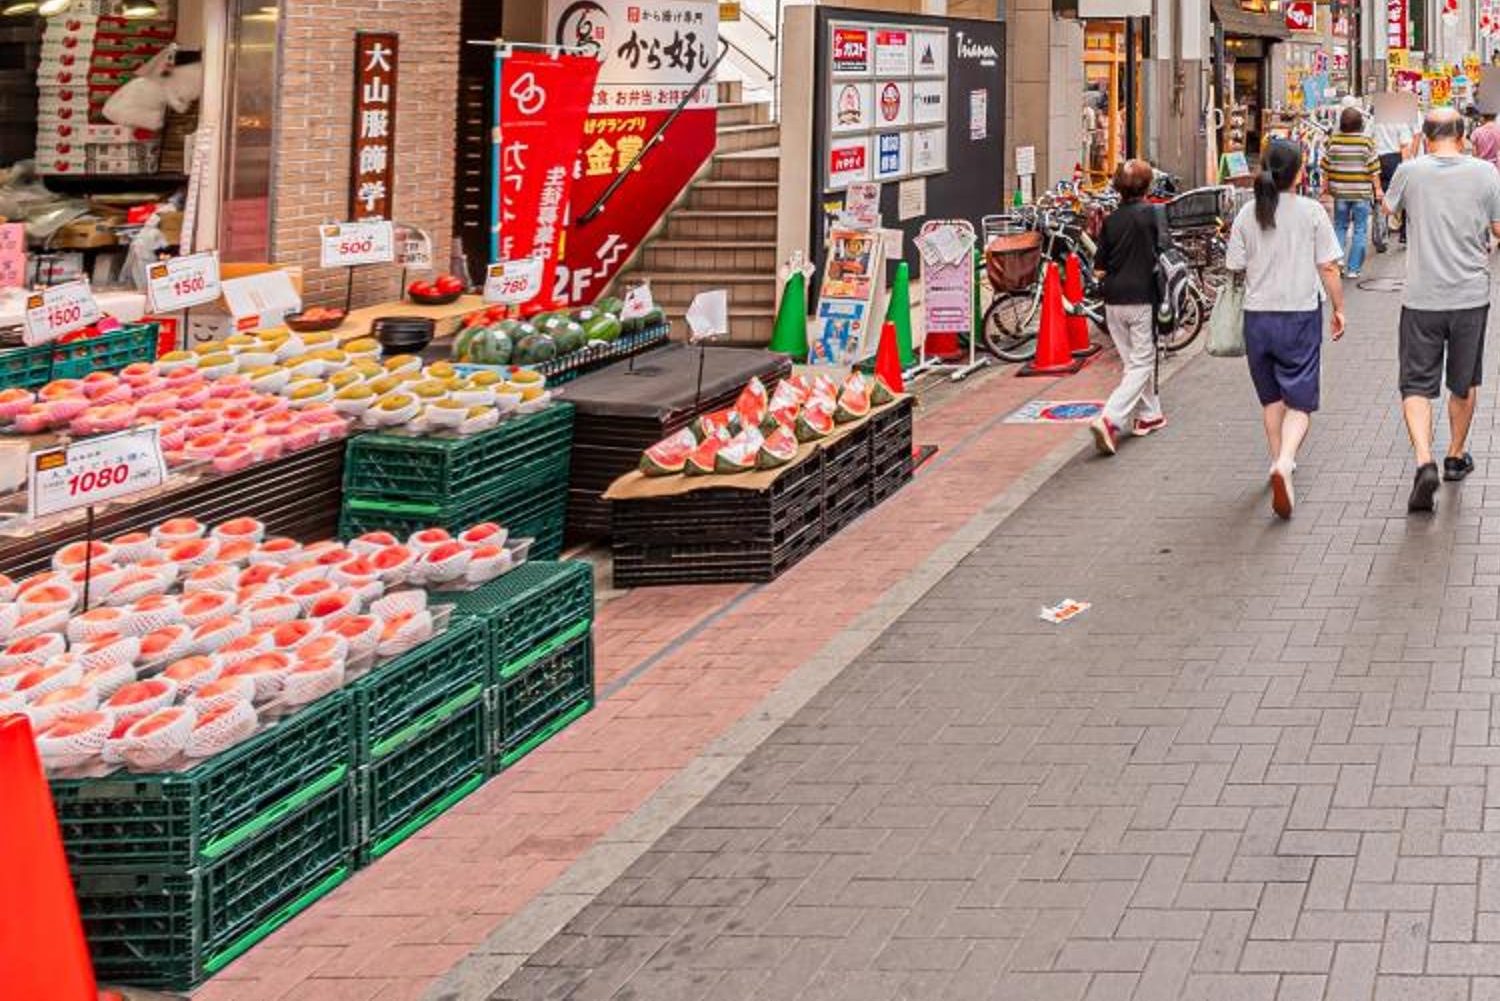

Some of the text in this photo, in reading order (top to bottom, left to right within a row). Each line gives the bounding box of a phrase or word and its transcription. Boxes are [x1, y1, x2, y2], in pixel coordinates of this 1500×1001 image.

[641, 10, 704, 26] から揚げ専門
[617, 30, 710, 74] から好し
[360, 42, 392, 221] 大山服飾学
[339, 241, 373, 255] 500
[173, 276, 206, 297] 1500
[551, 265, 594, 306] 2F
[47, 305, 82, 326] 1500
[68, 463, 130, 497] 1080
